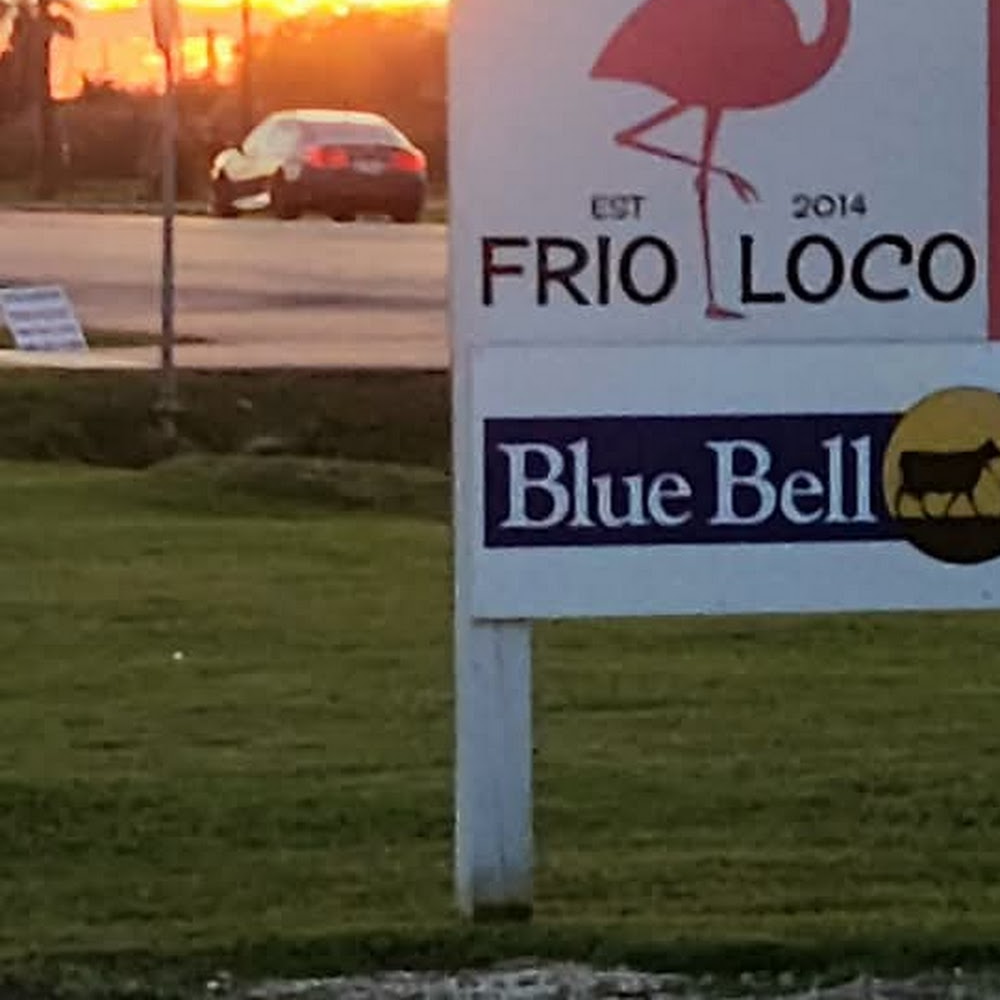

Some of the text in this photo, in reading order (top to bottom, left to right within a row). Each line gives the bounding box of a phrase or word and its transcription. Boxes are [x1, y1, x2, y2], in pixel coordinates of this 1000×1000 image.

[590, 193, 868, 220] EST 2014
[480, 232, 976, 307] FRIO LOCO
[498, 440, 693, 530] Blue
[705, 435, 873, 526] Bell
